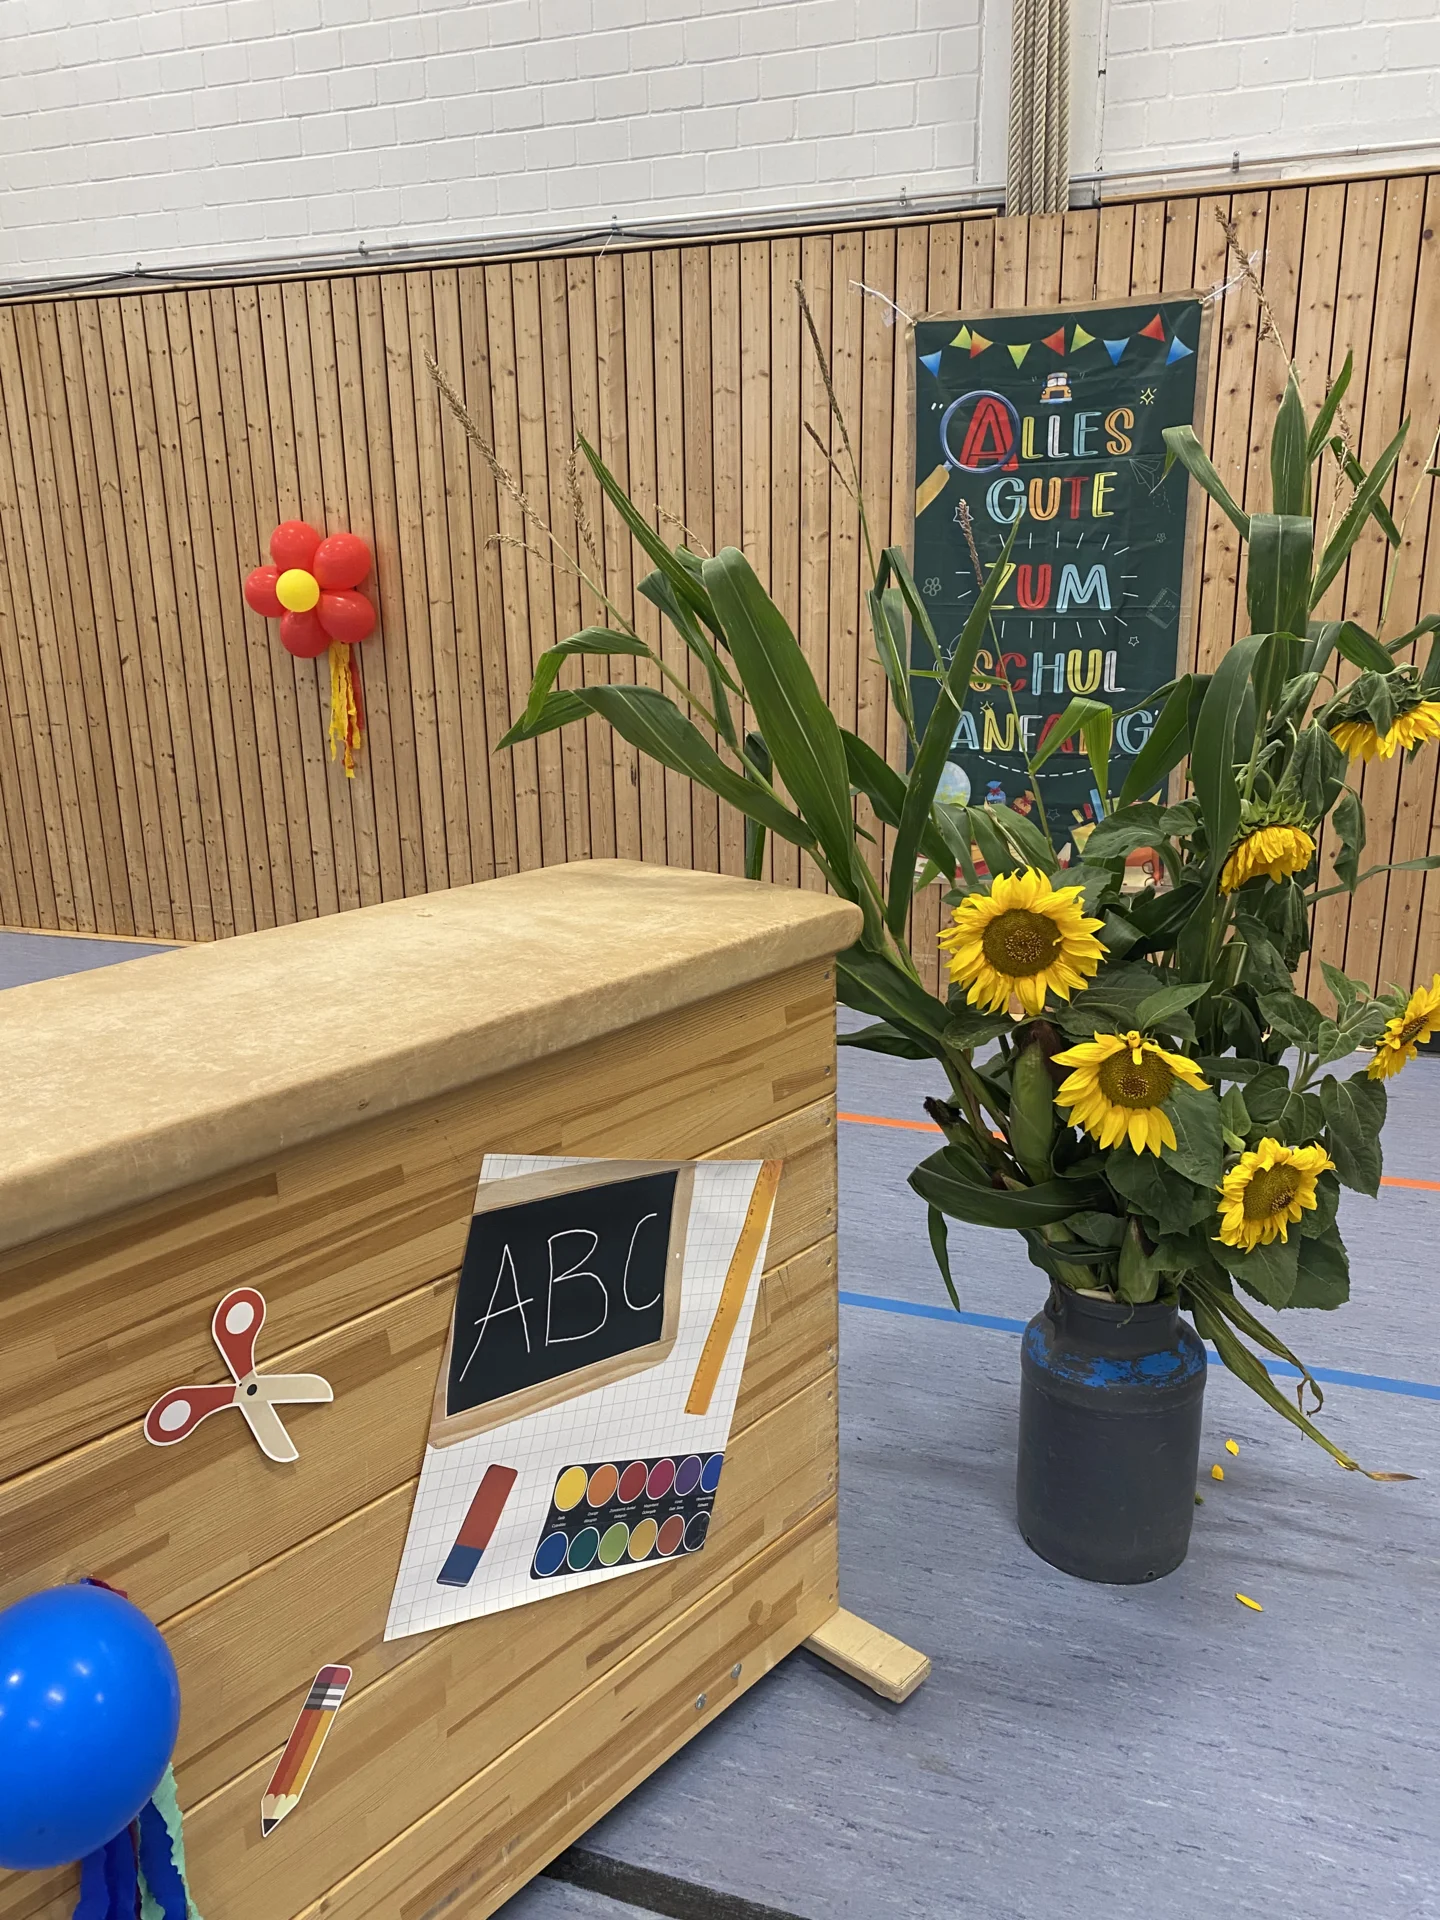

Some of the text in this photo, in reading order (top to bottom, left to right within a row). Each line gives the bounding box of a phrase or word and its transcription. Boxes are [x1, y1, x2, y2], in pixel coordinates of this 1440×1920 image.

[959, 396, 1135, 471] ALLES
[985, 471, 1118, 524] GUTE
[984, 562, 1112, 613] ZUM
[969, 649, 1126, 696] SCHUL
[950, 707, 1154, 755] ANFG
[459, 1212, 661, 1382] ABC
